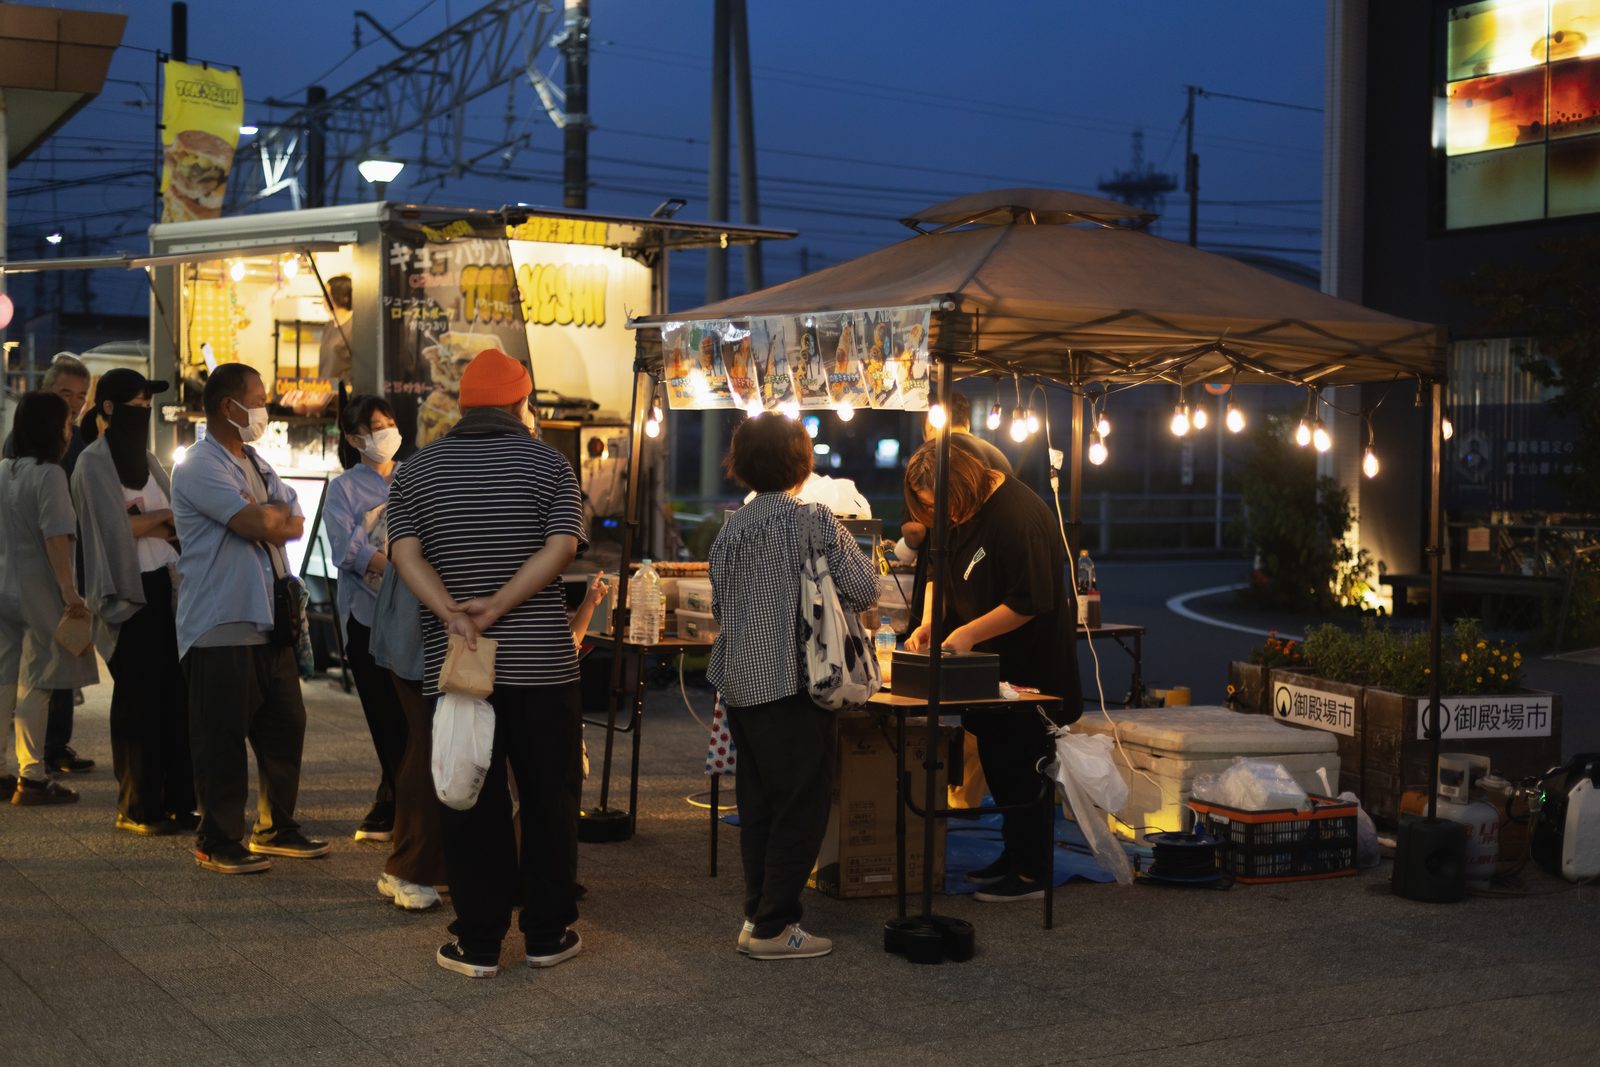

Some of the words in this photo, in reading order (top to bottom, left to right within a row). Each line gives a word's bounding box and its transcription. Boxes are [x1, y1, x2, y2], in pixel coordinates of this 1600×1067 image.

[1293, 691, 1353, 729] 御殿場市
[1454, 702, 1549, 731] 御殿場市
